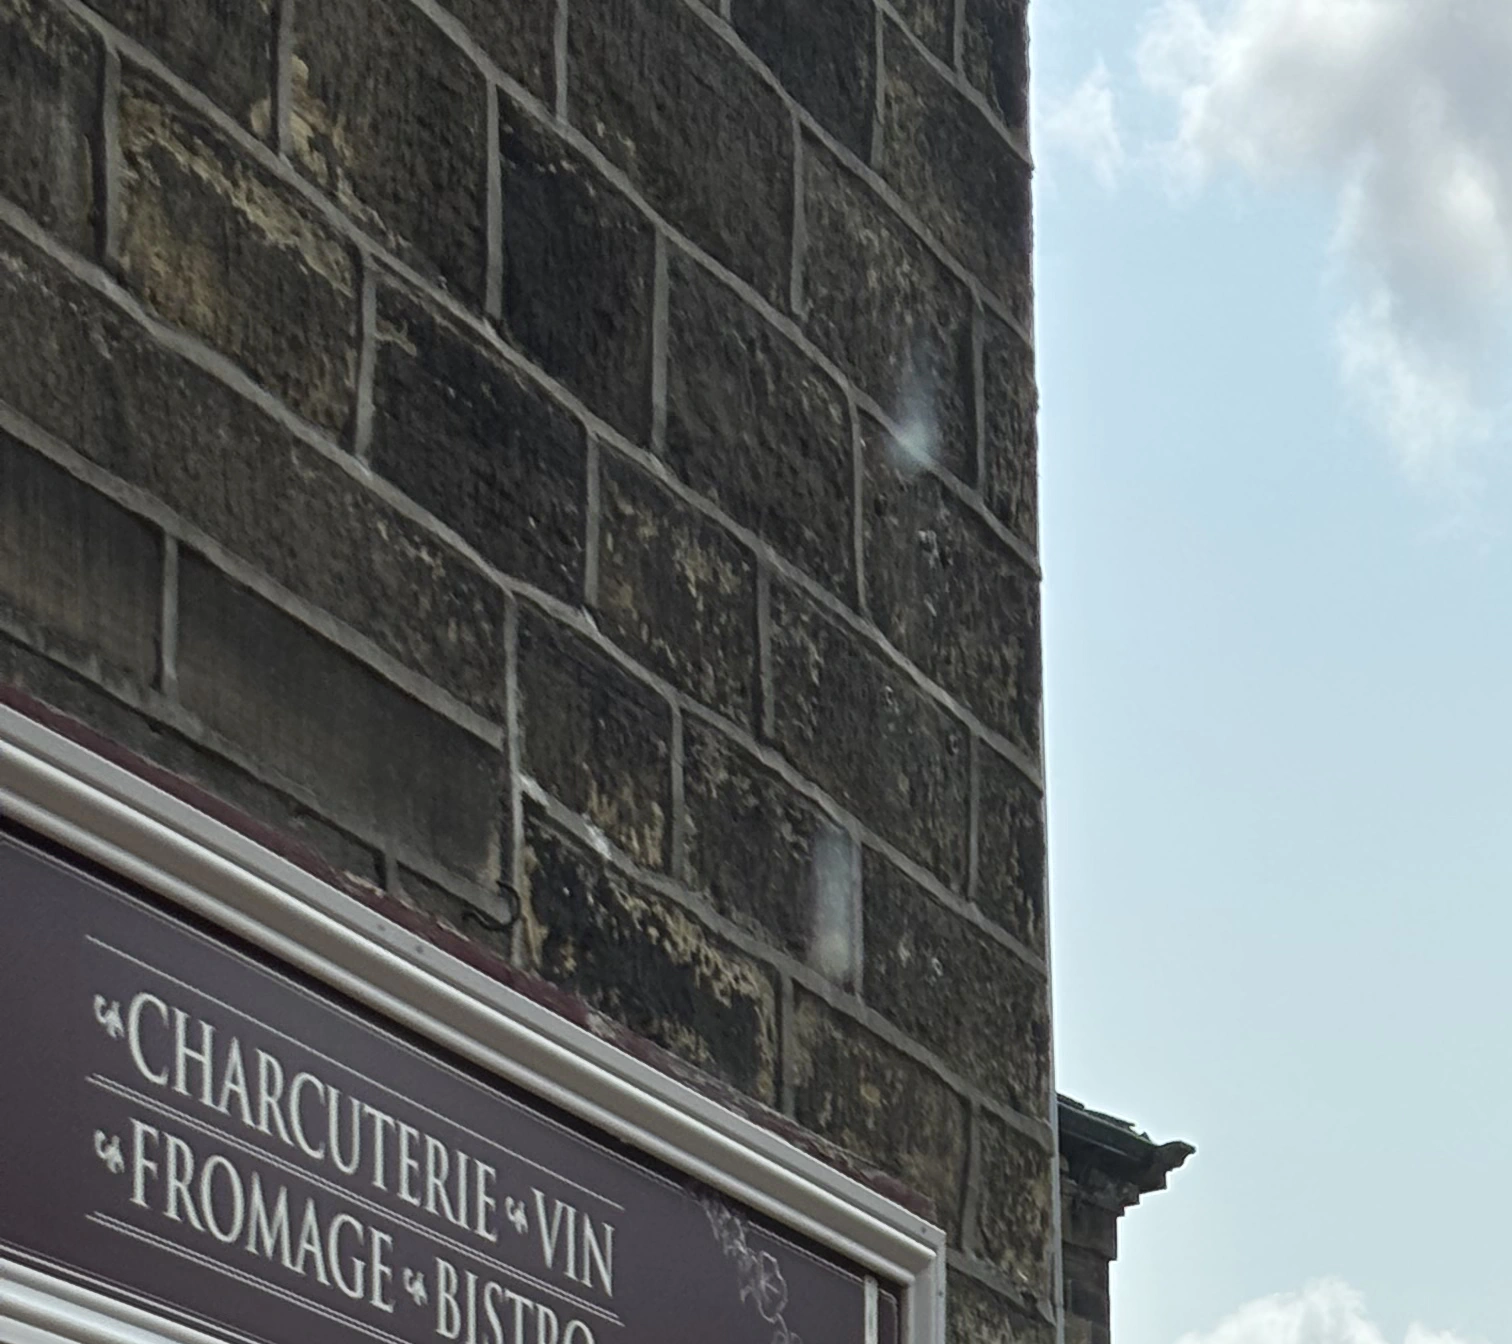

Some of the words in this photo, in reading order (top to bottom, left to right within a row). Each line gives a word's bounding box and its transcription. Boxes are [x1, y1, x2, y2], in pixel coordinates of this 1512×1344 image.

[128, 992, 498, 1241] CHARCUTERIE
[530, 1186, 615, 1297] VIN
[129, 1117, 394, 1313] FROMAGE
